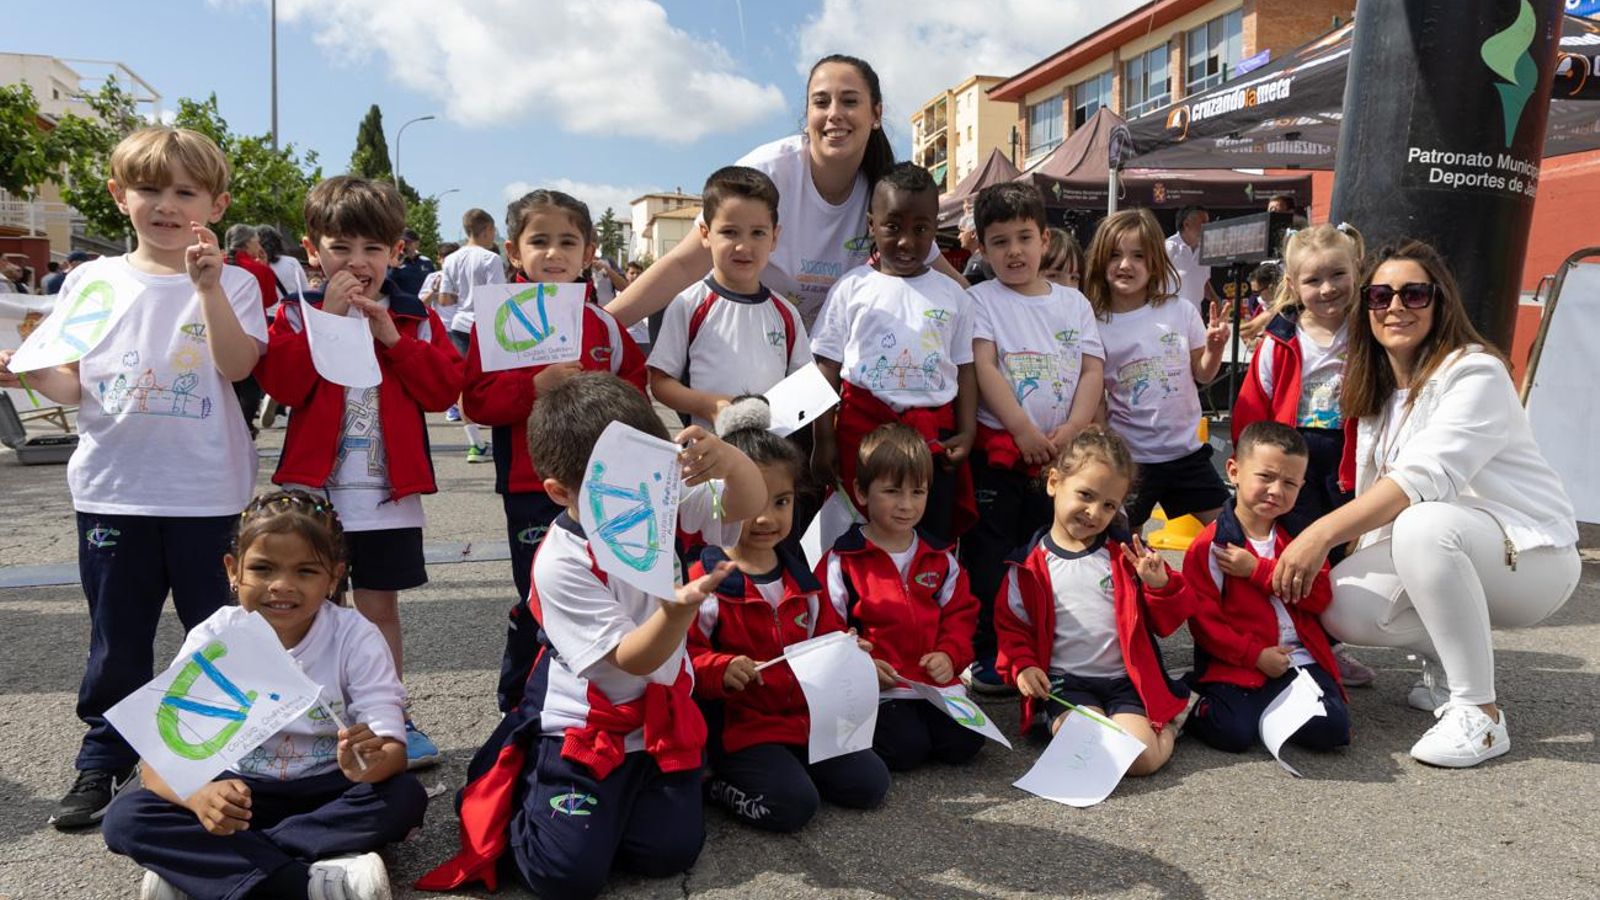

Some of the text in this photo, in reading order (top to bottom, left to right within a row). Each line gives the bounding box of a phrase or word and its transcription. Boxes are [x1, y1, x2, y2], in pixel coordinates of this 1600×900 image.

[1408, 147, 1539, 180] Patronato Municip
[1429, 167, 1505, 189] Deportes
[1509, 177, 1523, 192] de
